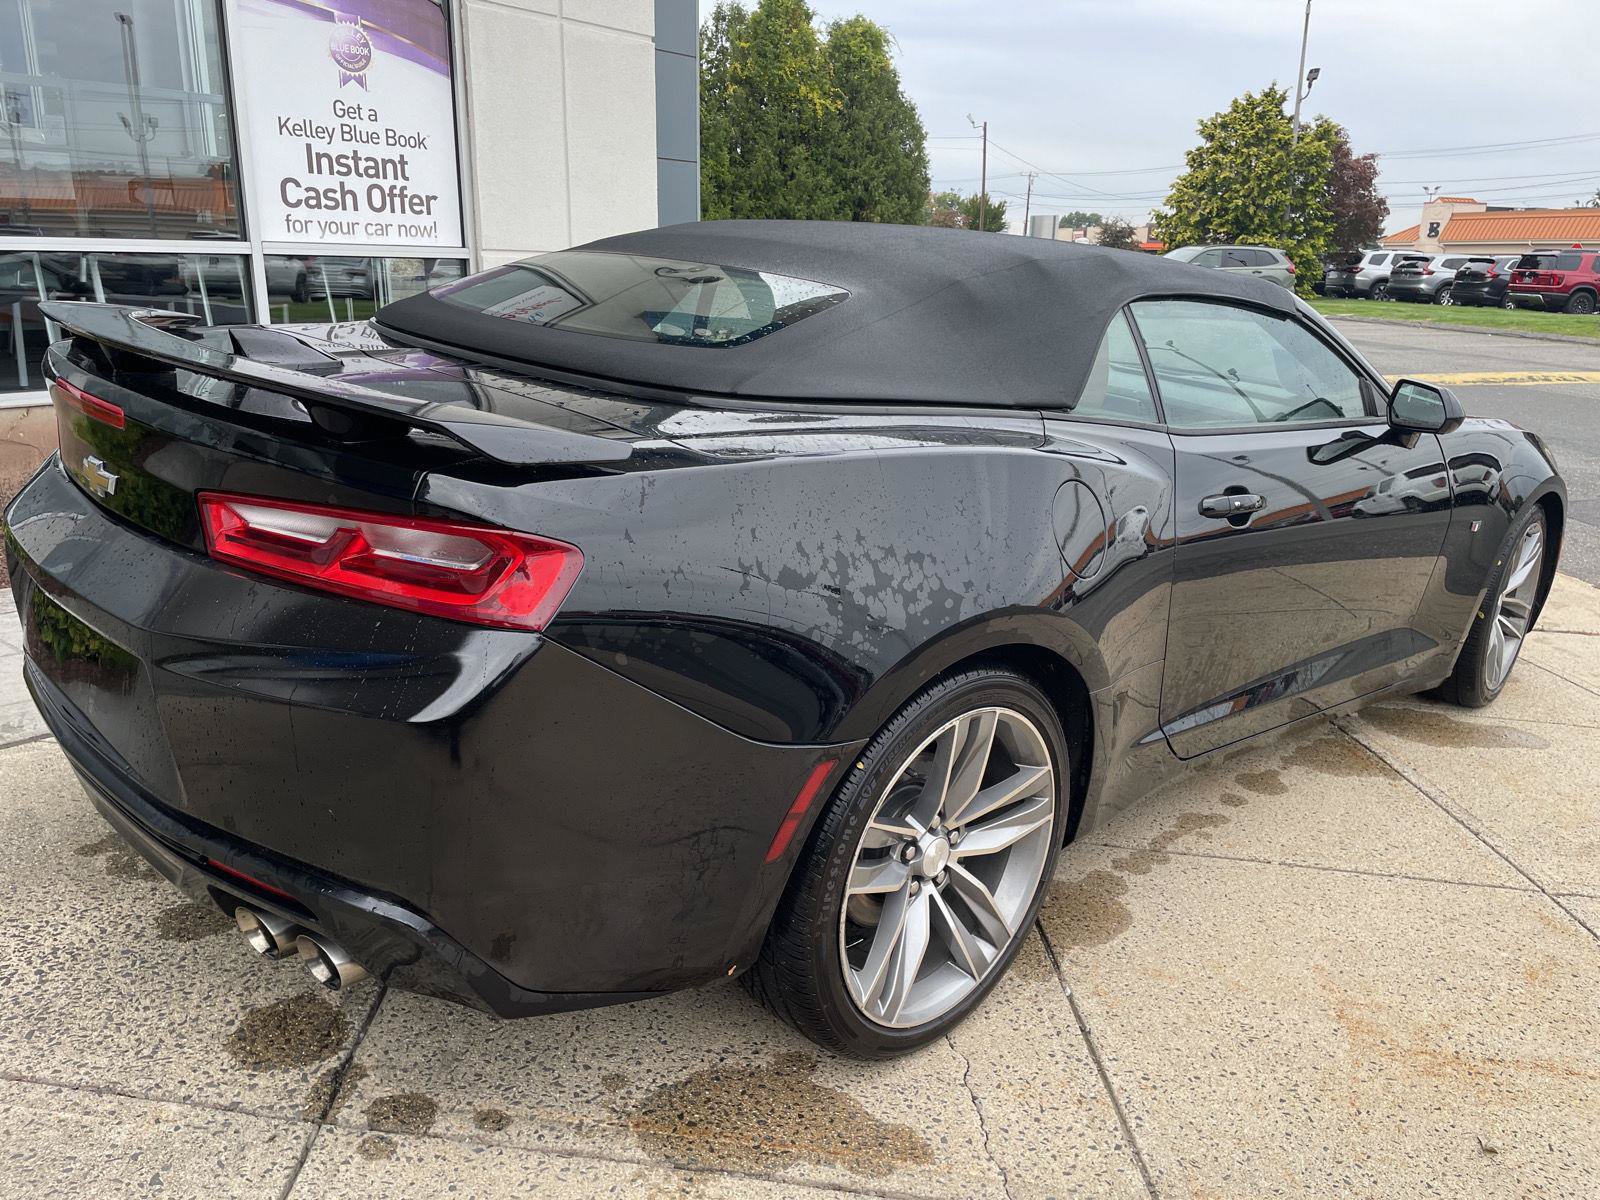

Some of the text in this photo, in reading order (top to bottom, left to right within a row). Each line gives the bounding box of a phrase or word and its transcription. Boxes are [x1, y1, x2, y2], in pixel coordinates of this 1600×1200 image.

[350, 45, 370, 56] BOOK
[332, 99, 378, 122] Get a
[277, 116, 428, 150] Kelley Blue Book
[305, 142, 410, 182] Instant
[280, 177, 439, 216] Cash Offer
[285, 213, 438, 239] for your car now!
